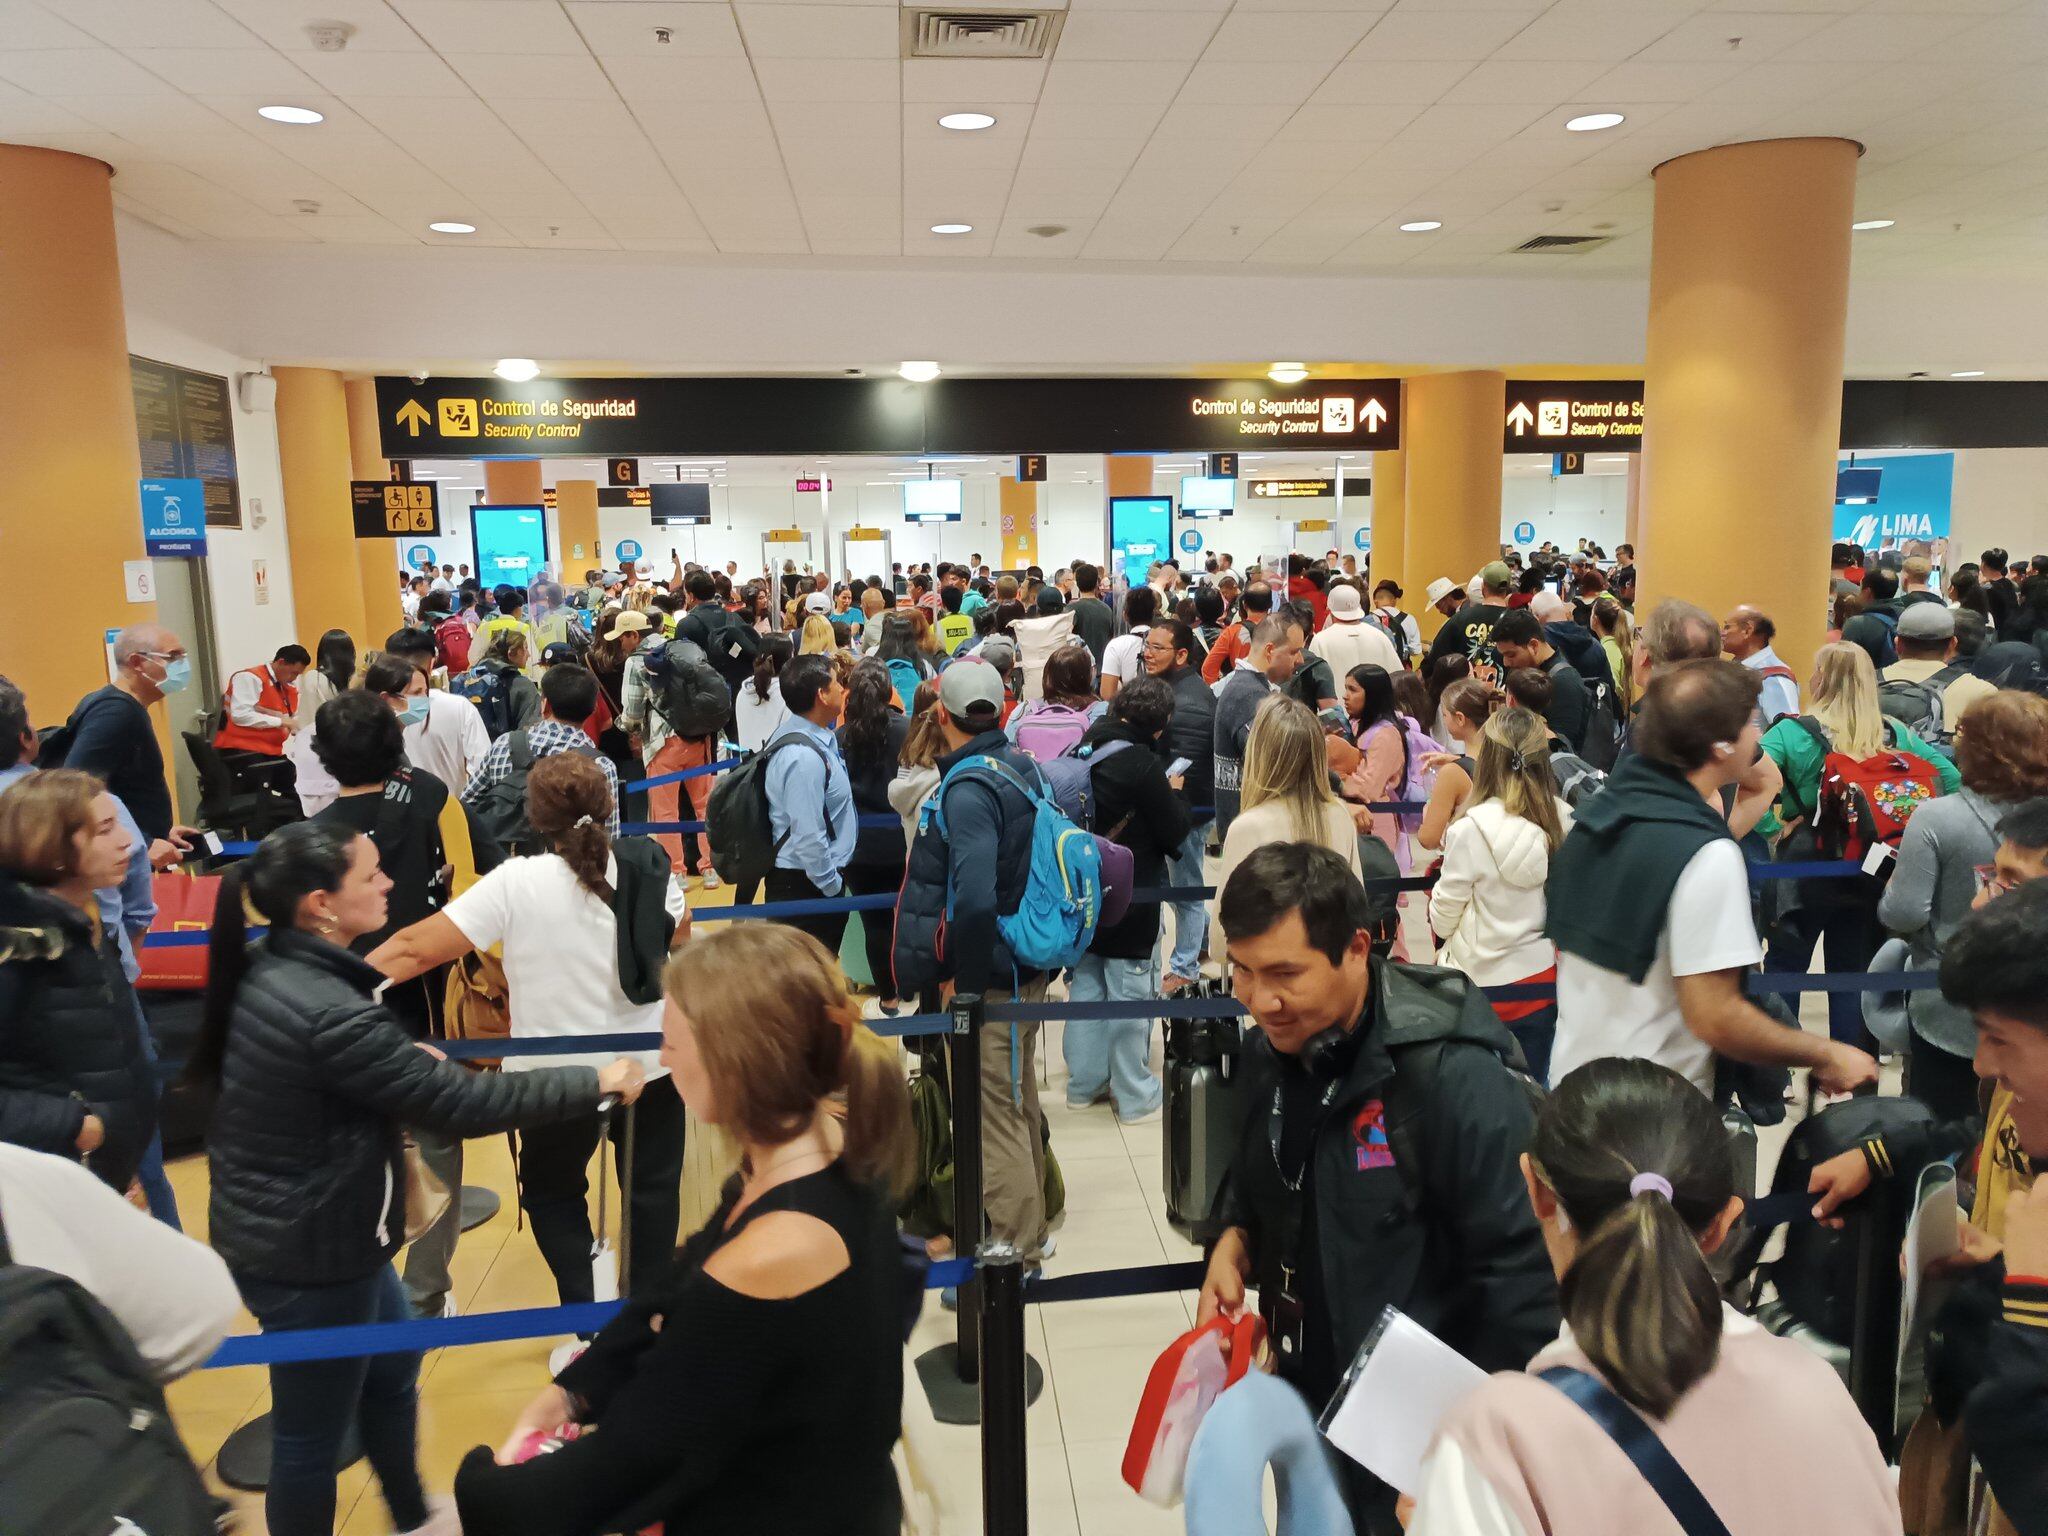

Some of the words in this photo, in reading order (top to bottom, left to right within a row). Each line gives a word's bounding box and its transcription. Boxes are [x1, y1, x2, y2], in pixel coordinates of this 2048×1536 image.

[482, 399, 536, 416] Control
[540, 399, 559, 416] de
[562, 399, 636, 420] Seguridad
[1192, 399, 1238, 415] Control
[1241, 399, 1256, 415] de
[1259, 399, 1320, 417] Seguridad
[1571, 401, 1613, 418] Control
[1614, 401, 1630, 418] de
[484, 423, 534, 440] Security
[536, 423, 582, 437] Control
[1240, 420, 1280, 436] Security
[1282, 420, 1320, 433] Control
[1571, 422, 1610, 438] Security
[1610, 422, 1644, 436] Control
[1028, 458, 1039, 477] F
[1220, 457, 1232, 475] E
[1566, 453, 1578, 470] D
[616, 461, 631, 481] G
[1881, 513, 1933, 536] LIMA
